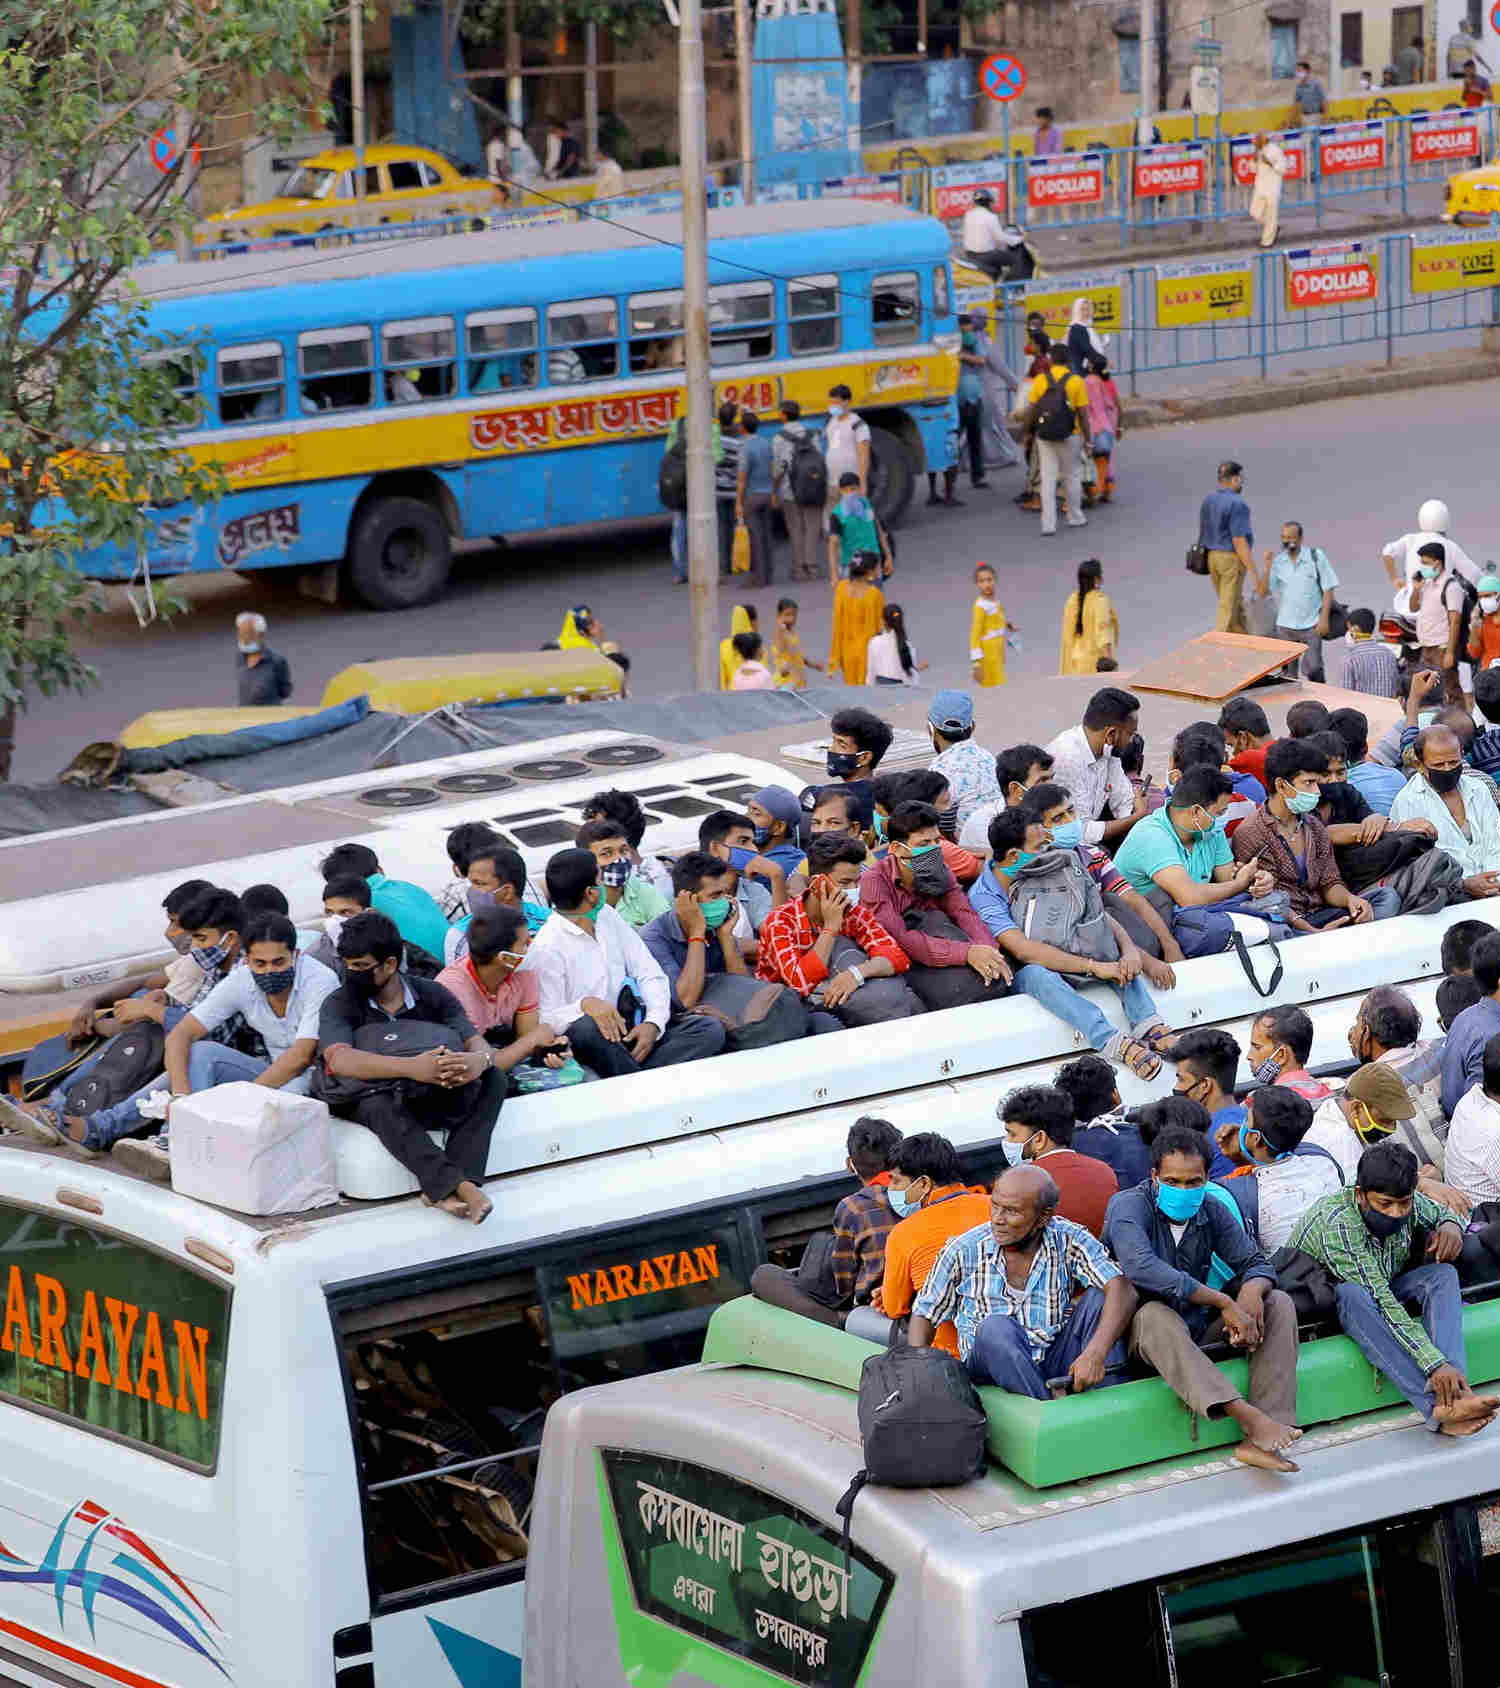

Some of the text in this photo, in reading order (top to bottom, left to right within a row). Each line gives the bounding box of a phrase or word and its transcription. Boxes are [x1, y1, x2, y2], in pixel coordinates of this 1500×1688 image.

[1337, 143, 1380, 164] DOLLAR
[1427, 131, 1473, 150] DOLLAR
[1049, 177, 1096, 197] DOLLAR
[1151, 165, 1198, 184] DOLLAR
[1418, 249, 1495, 273] LUX cozi
[1164, 279, 1245, 305] LUX cozi
[1309, 270, 1369, 293] DOLLAR
[470, 389, 681, 450] জয় মা তারা
[567, 1244, 720, 1311] NARAYAN
[0, 1264, 209, 1420] ARAYAN
[756, 1531, 853, 1623] হাওড়া
[673, 1575, 718, 1616] এগরা
[755, 1608, 829, 1667] ভগবানপুর
